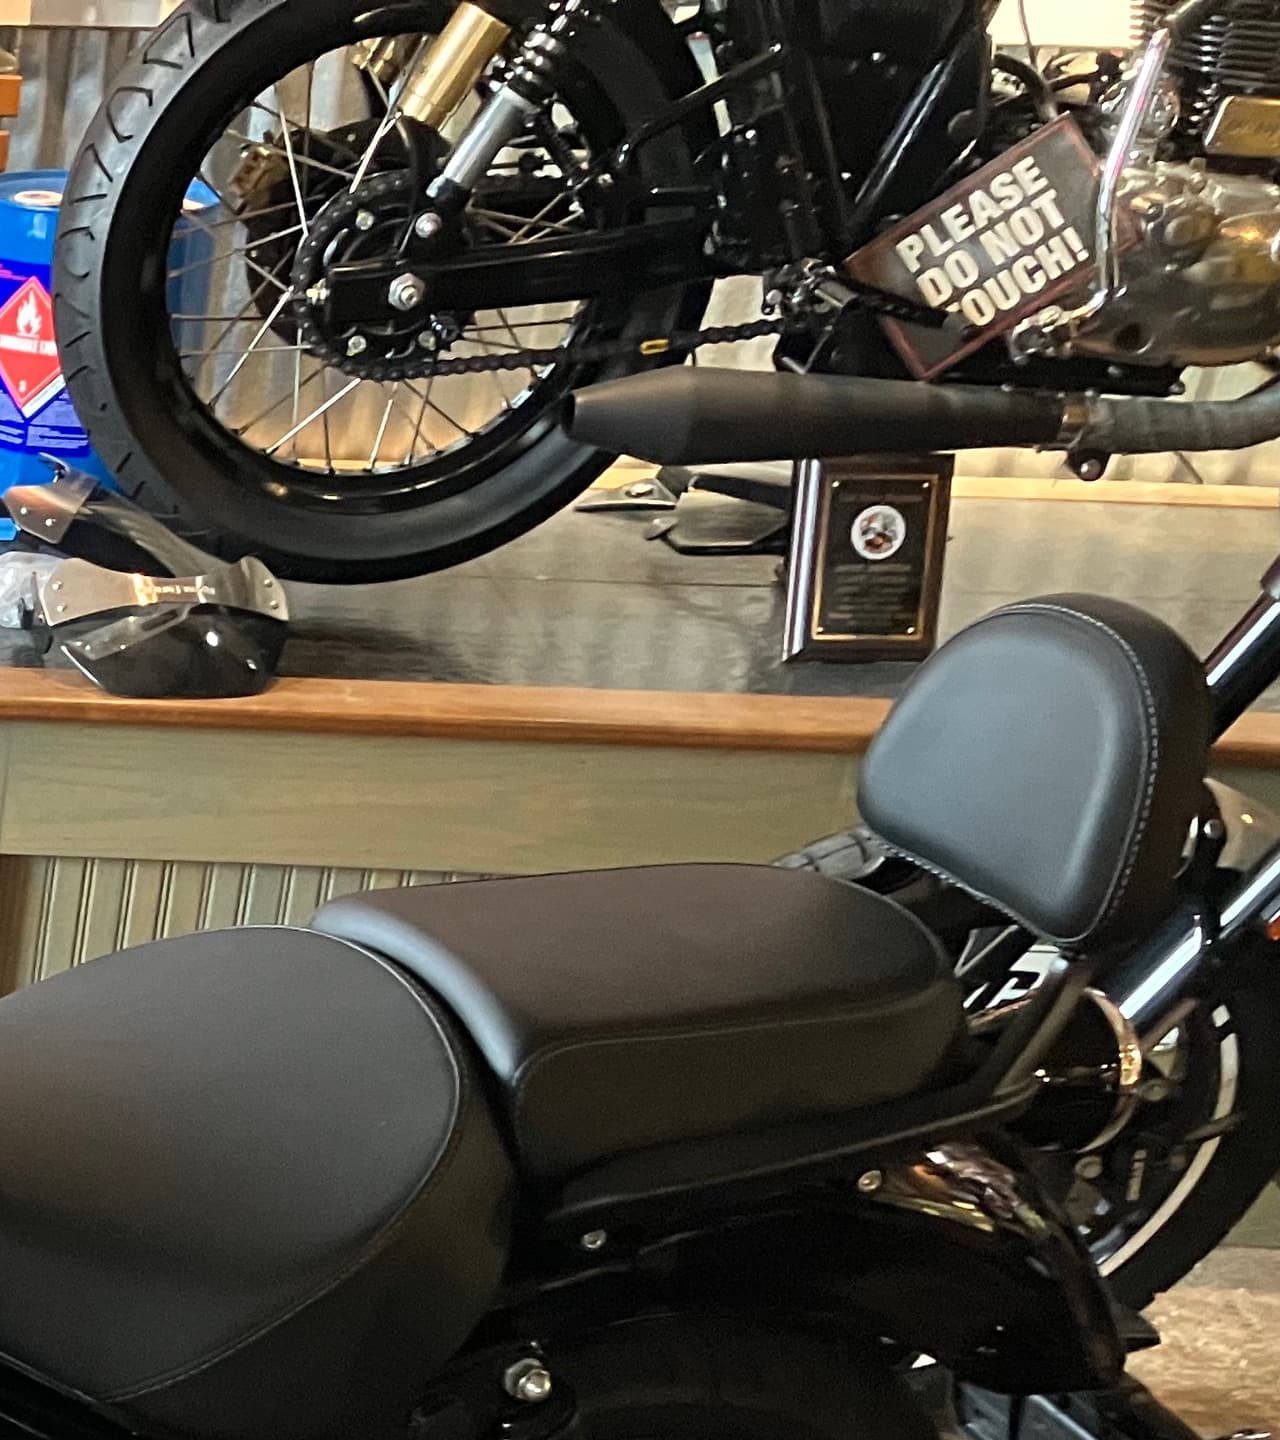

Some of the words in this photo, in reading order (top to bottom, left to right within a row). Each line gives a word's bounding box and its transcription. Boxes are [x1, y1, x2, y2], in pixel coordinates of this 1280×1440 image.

[895, 156, 1048, 272] PLEASE
[915, 250, 980, 308] DO
[979, 188, 1065, 266] NOT
[945, 226, 1090, 327] OUCH!
